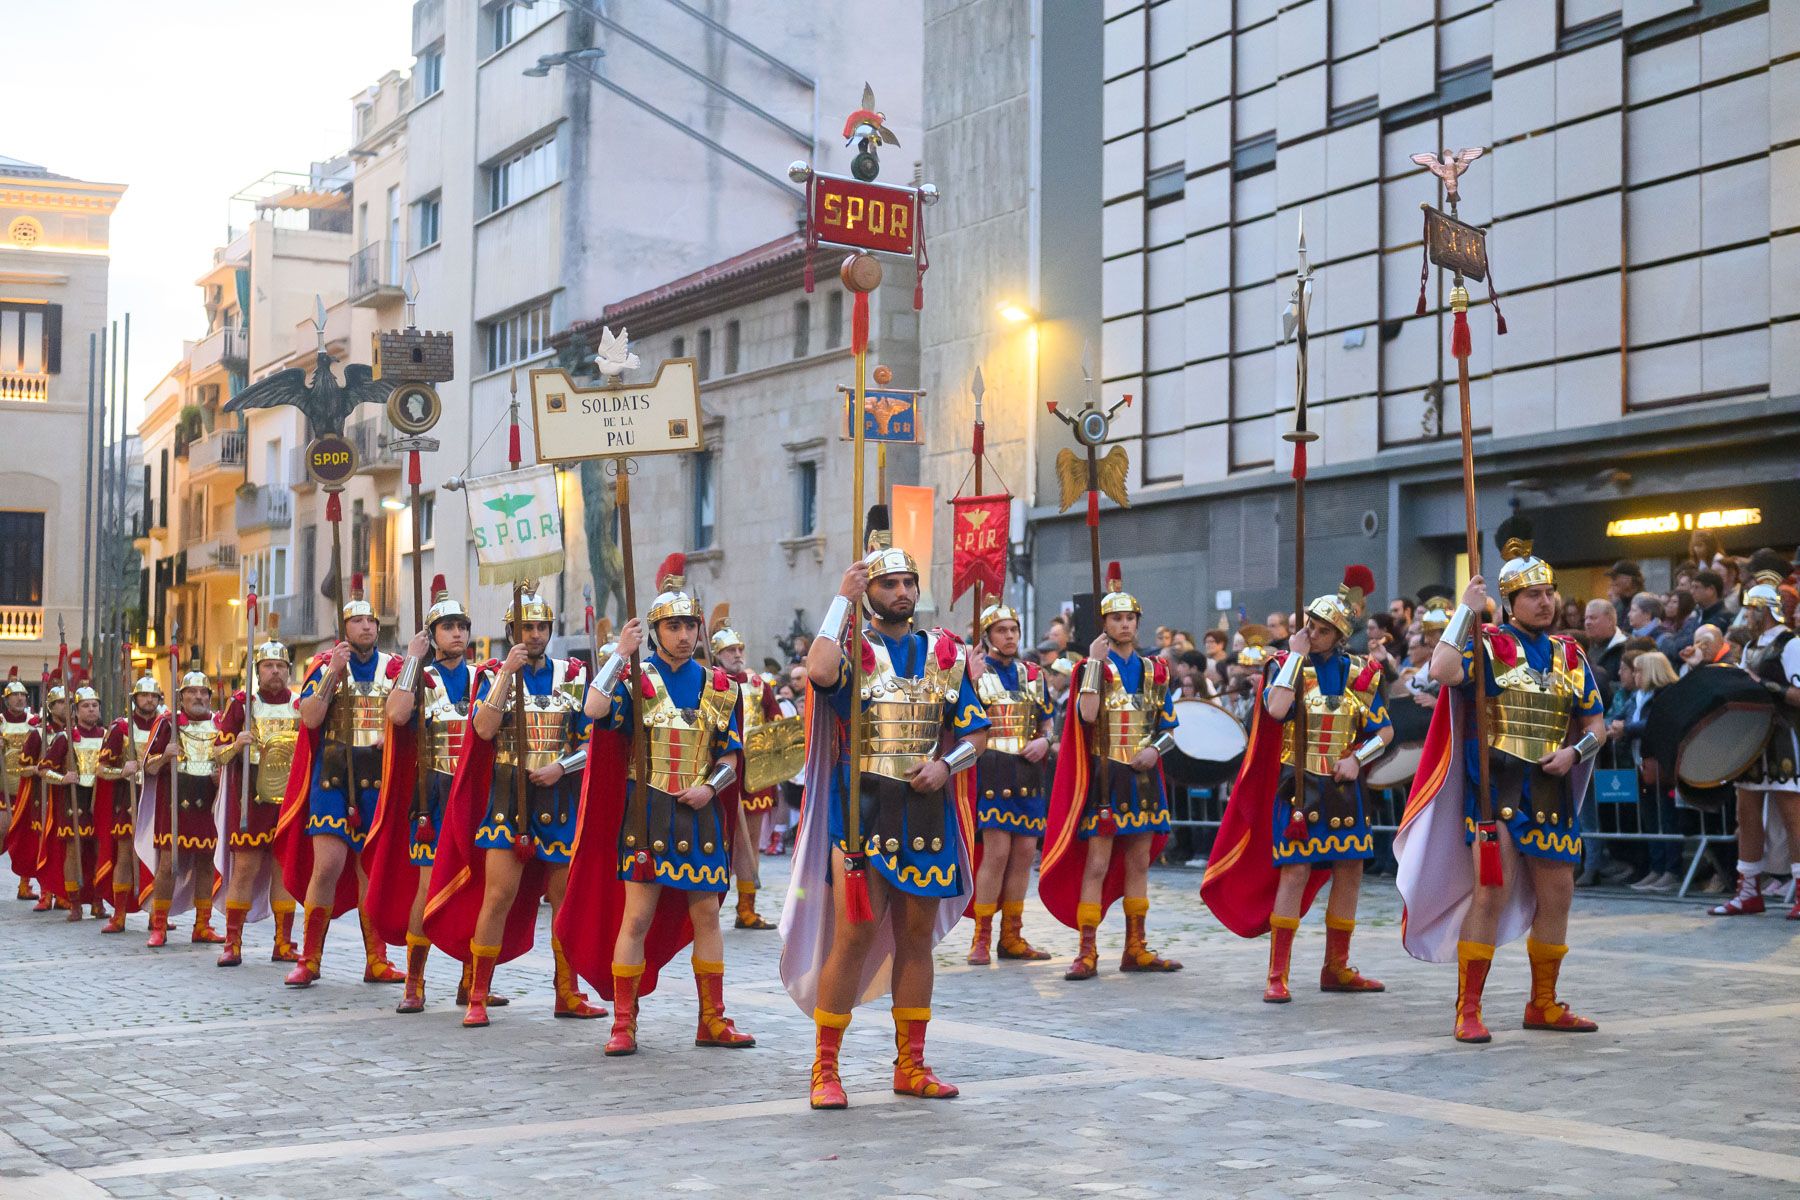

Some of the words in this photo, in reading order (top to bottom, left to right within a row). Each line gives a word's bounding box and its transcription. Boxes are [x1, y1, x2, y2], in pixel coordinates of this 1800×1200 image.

[824, 193, 908, 238] SPQR
[581, 394, 650, 415] SOLDATS
[603, 416, 617, 427] DE
[620, 415, 634, 426] LA
[607, 430, 635, 447] PAU
